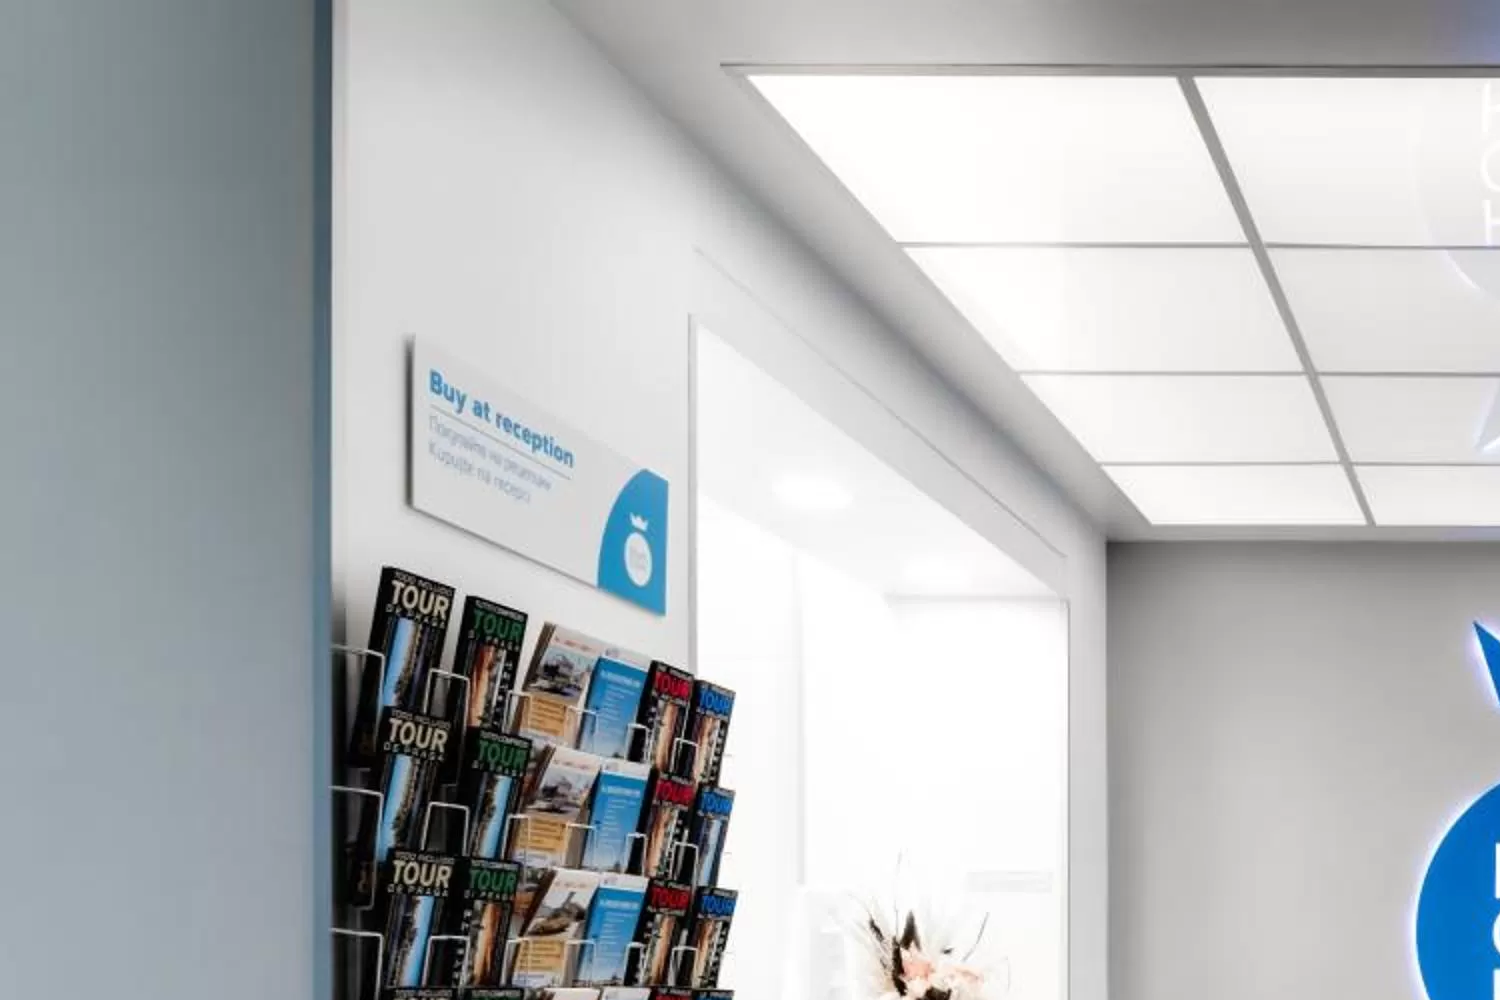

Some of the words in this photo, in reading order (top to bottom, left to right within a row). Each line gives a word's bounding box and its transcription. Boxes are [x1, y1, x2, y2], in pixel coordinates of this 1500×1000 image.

[429, 368, 468, 415] Buy
[472, 400, 491, 423] at
[496, 411, 574, 469] reception
[391, 579, 450, 621] TOUR
[473, 608, 523, 639] TOUR
[389, 717, 448, 753] TOUR
[478, 739, 527, 767] TOUR
[392, 859, 452, 889] TOUR
[469, 869, 518, 893] TOUR
